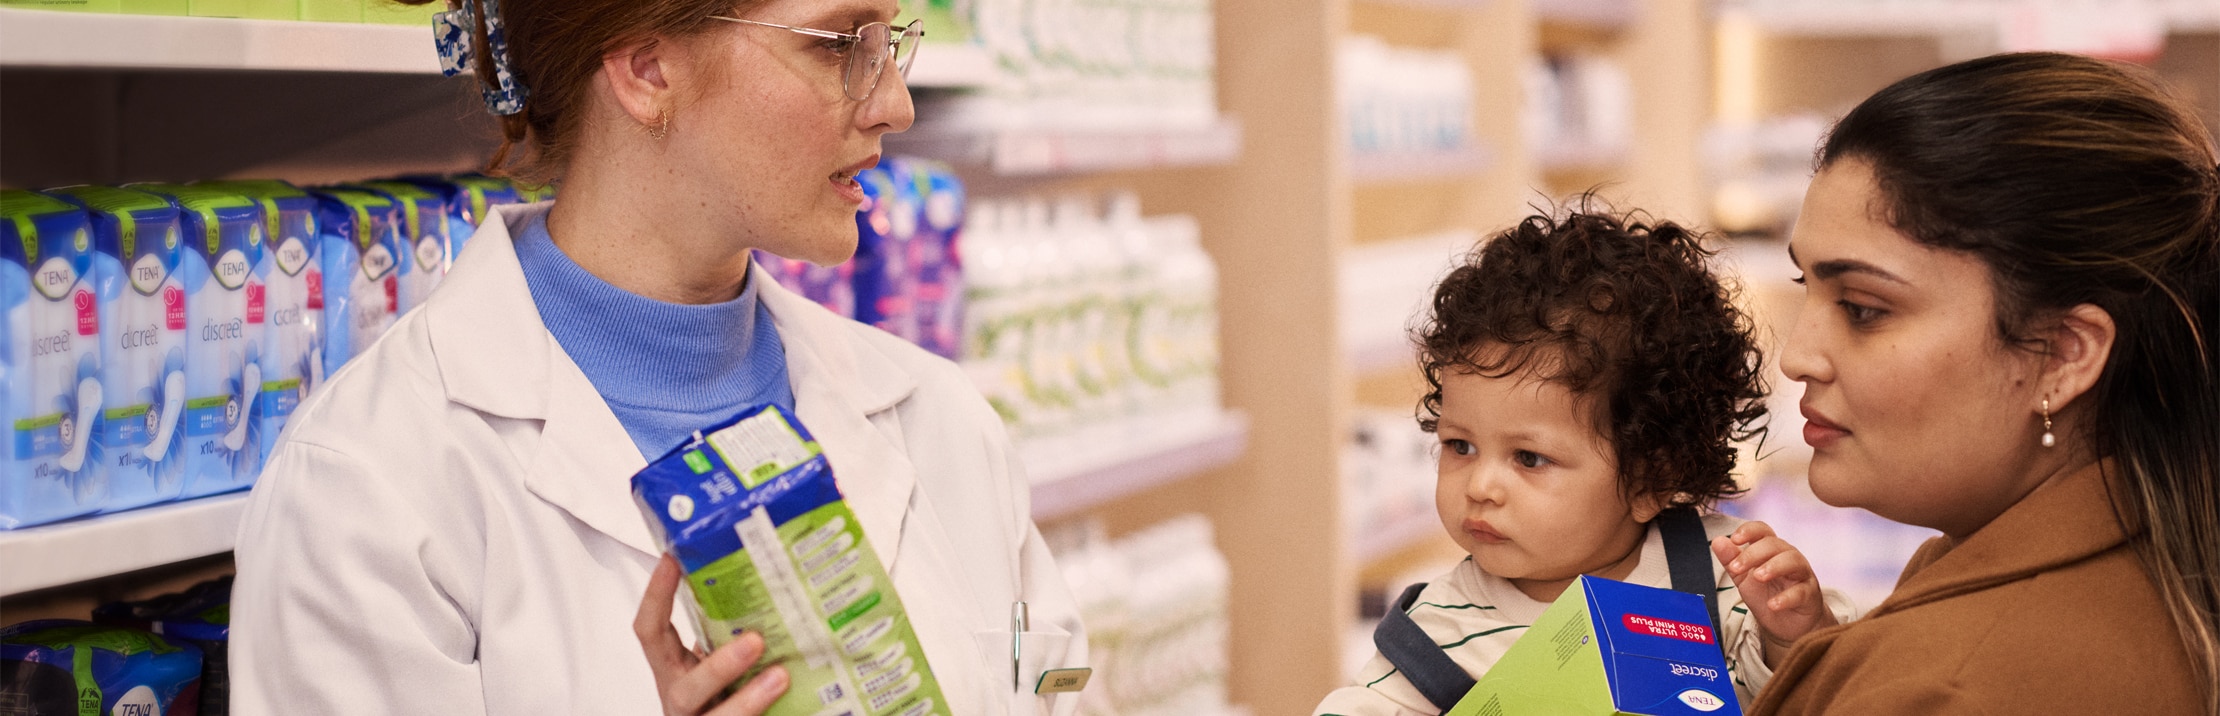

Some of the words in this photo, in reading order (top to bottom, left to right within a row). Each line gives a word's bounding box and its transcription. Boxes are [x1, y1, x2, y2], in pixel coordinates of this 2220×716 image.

[137, 265, 160, 281] TENA
[223, 261, 246, 276] TENA
[43, 270, 70, 286] TENA
[121, 323, 159, 350] dicreet
[202, 317, 243, 342] discreet
[200, 440, 215, 455] x10
[118, 451, 133, 466] x1
[34, 462, 49, 479] x10
[1630, 616, 1654, 627] PLUS
[1654, 620, 1676, 630] MINI
[1648, 626, 1678, 637] ULTRA
[1669, 663, 1719, 682] discreet
[81, 700, 99, 709] TENA
[1688, 695, 1716, 706] TENA
[122, 704, 151, 716] TENA
